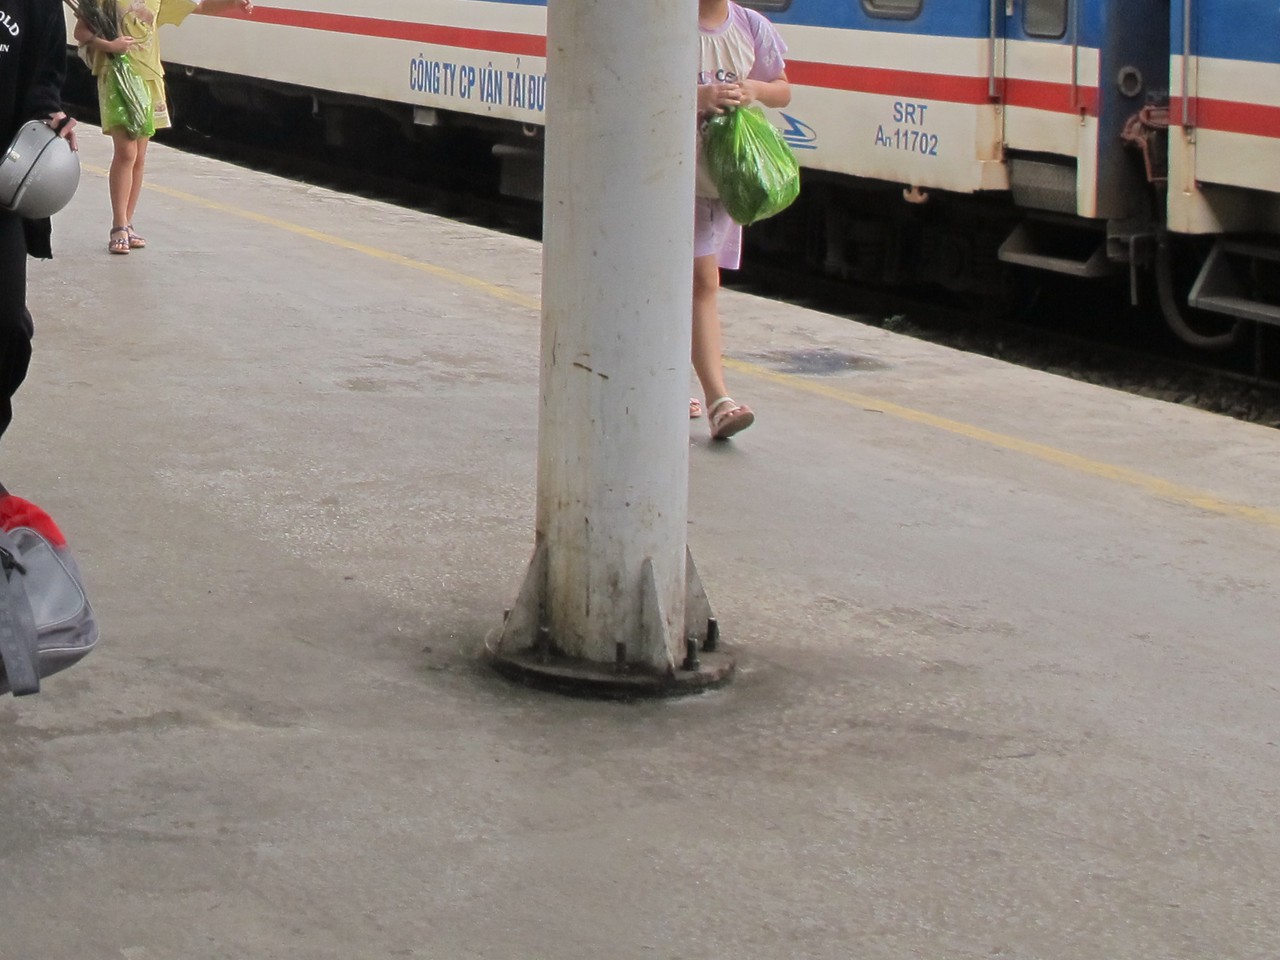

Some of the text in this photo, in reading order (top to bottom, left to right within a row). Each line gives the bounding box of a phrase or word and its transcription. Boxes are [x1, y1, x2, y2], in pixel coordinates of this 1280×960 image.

[410, 52, 440, 95] CÔNG
[443, 62, 457, 97] TY
[460, 65, 475, 100] CP
[479, 61, 503, 111] VẬN
[507, 57, 526, 109] TẢI
[893, 101, 928, 126] SRT
